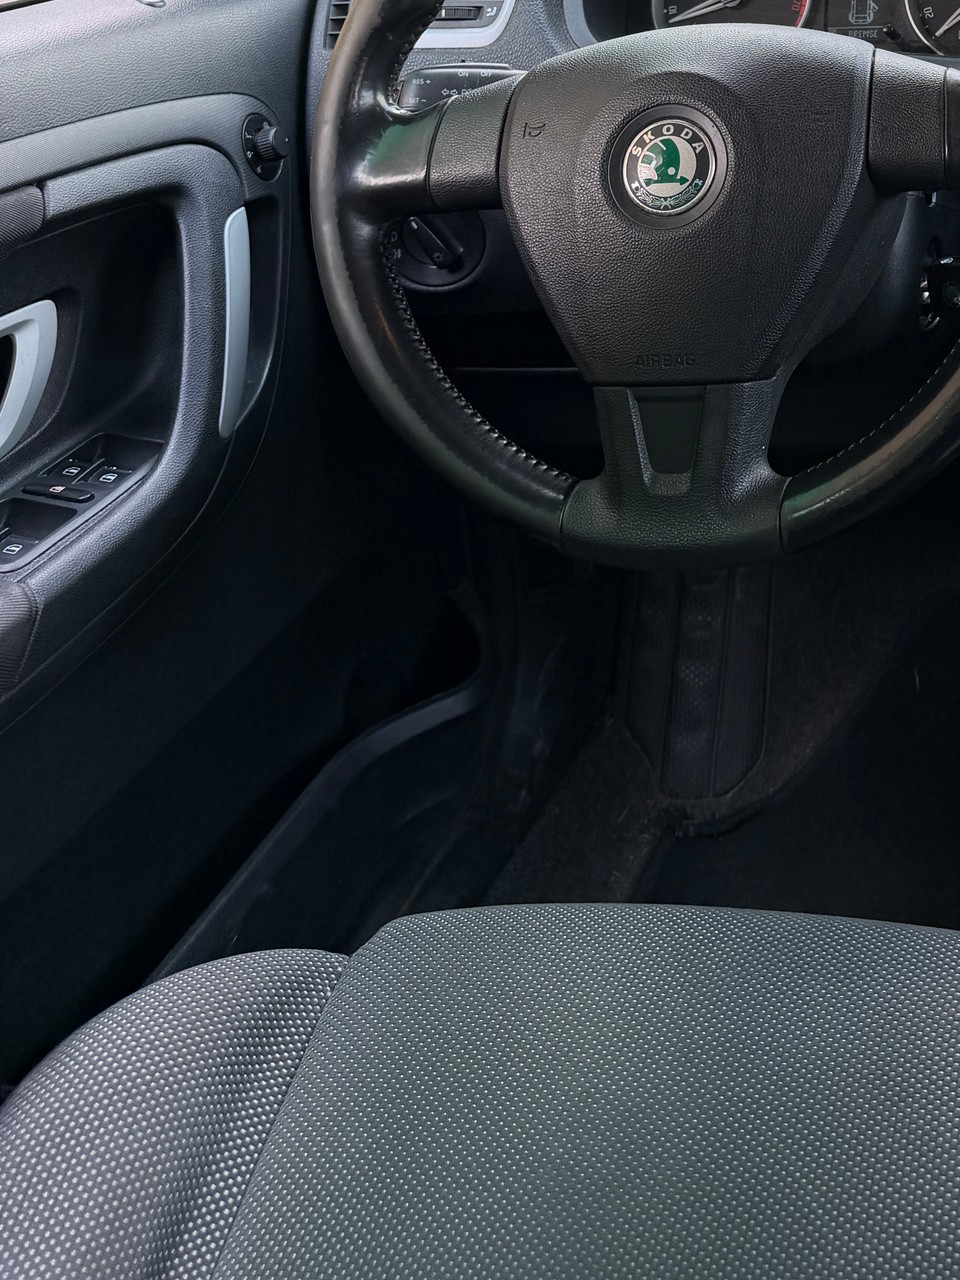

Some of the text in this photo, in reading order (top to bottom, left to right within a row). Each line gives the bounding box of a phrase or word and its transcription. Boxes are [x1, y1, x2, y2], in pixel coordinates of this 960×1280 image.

[668, 5, 678, 15] 10
[792, 0, 801, 12] 70
[923, 6, 935, 19] 20
[848, 29, 879, 39] BREMSE
